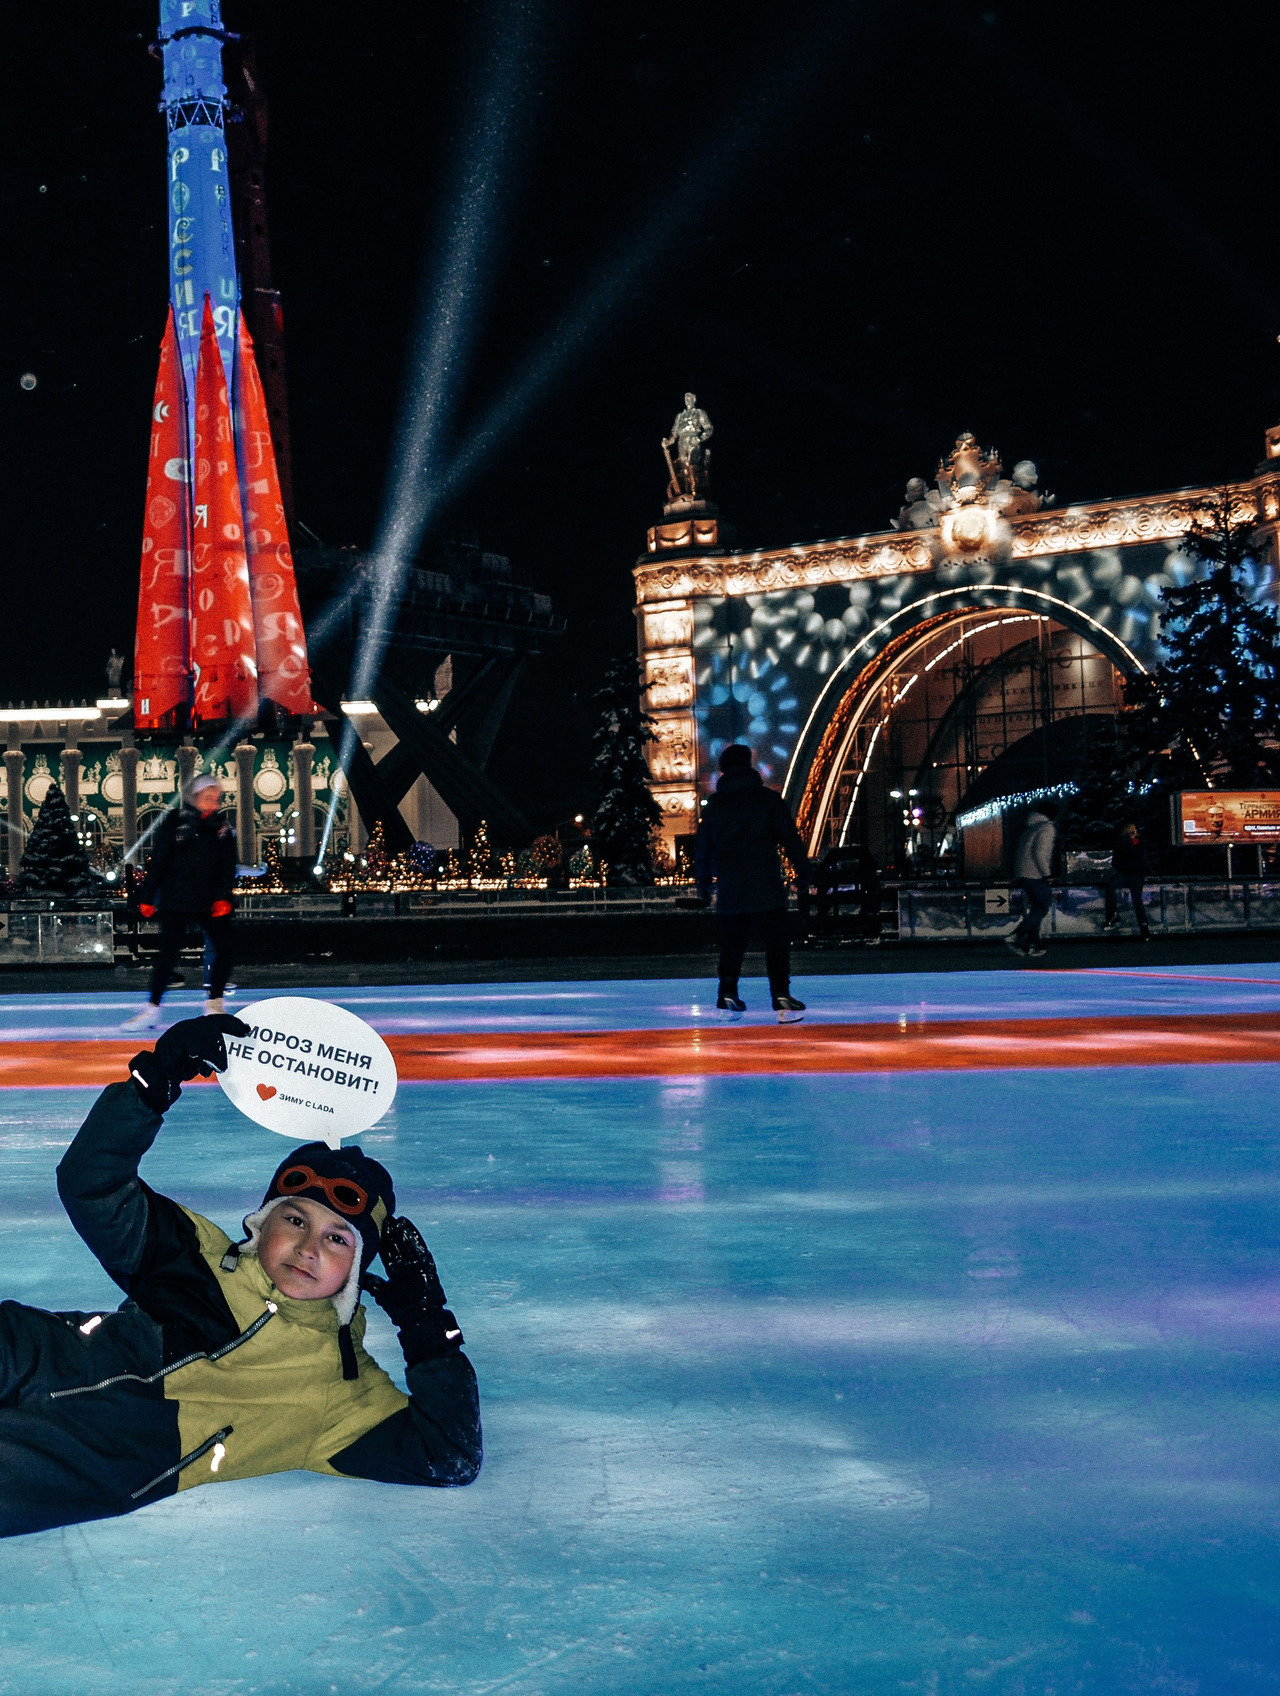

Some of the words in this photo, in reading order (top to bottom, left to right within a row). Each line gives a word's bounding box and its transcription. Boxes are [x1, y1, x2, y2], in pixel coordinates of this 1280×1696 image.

[228, 1041, 255, 1061] НЕ
[258, 1050, 380, 1095] ОСТАНОВИТ!
[317, 1043, 373, 1070] МЕНЯ
[279, 1093, 304, 1105] ЗИМУ
[312, 1101, 335, 1114] LADA
